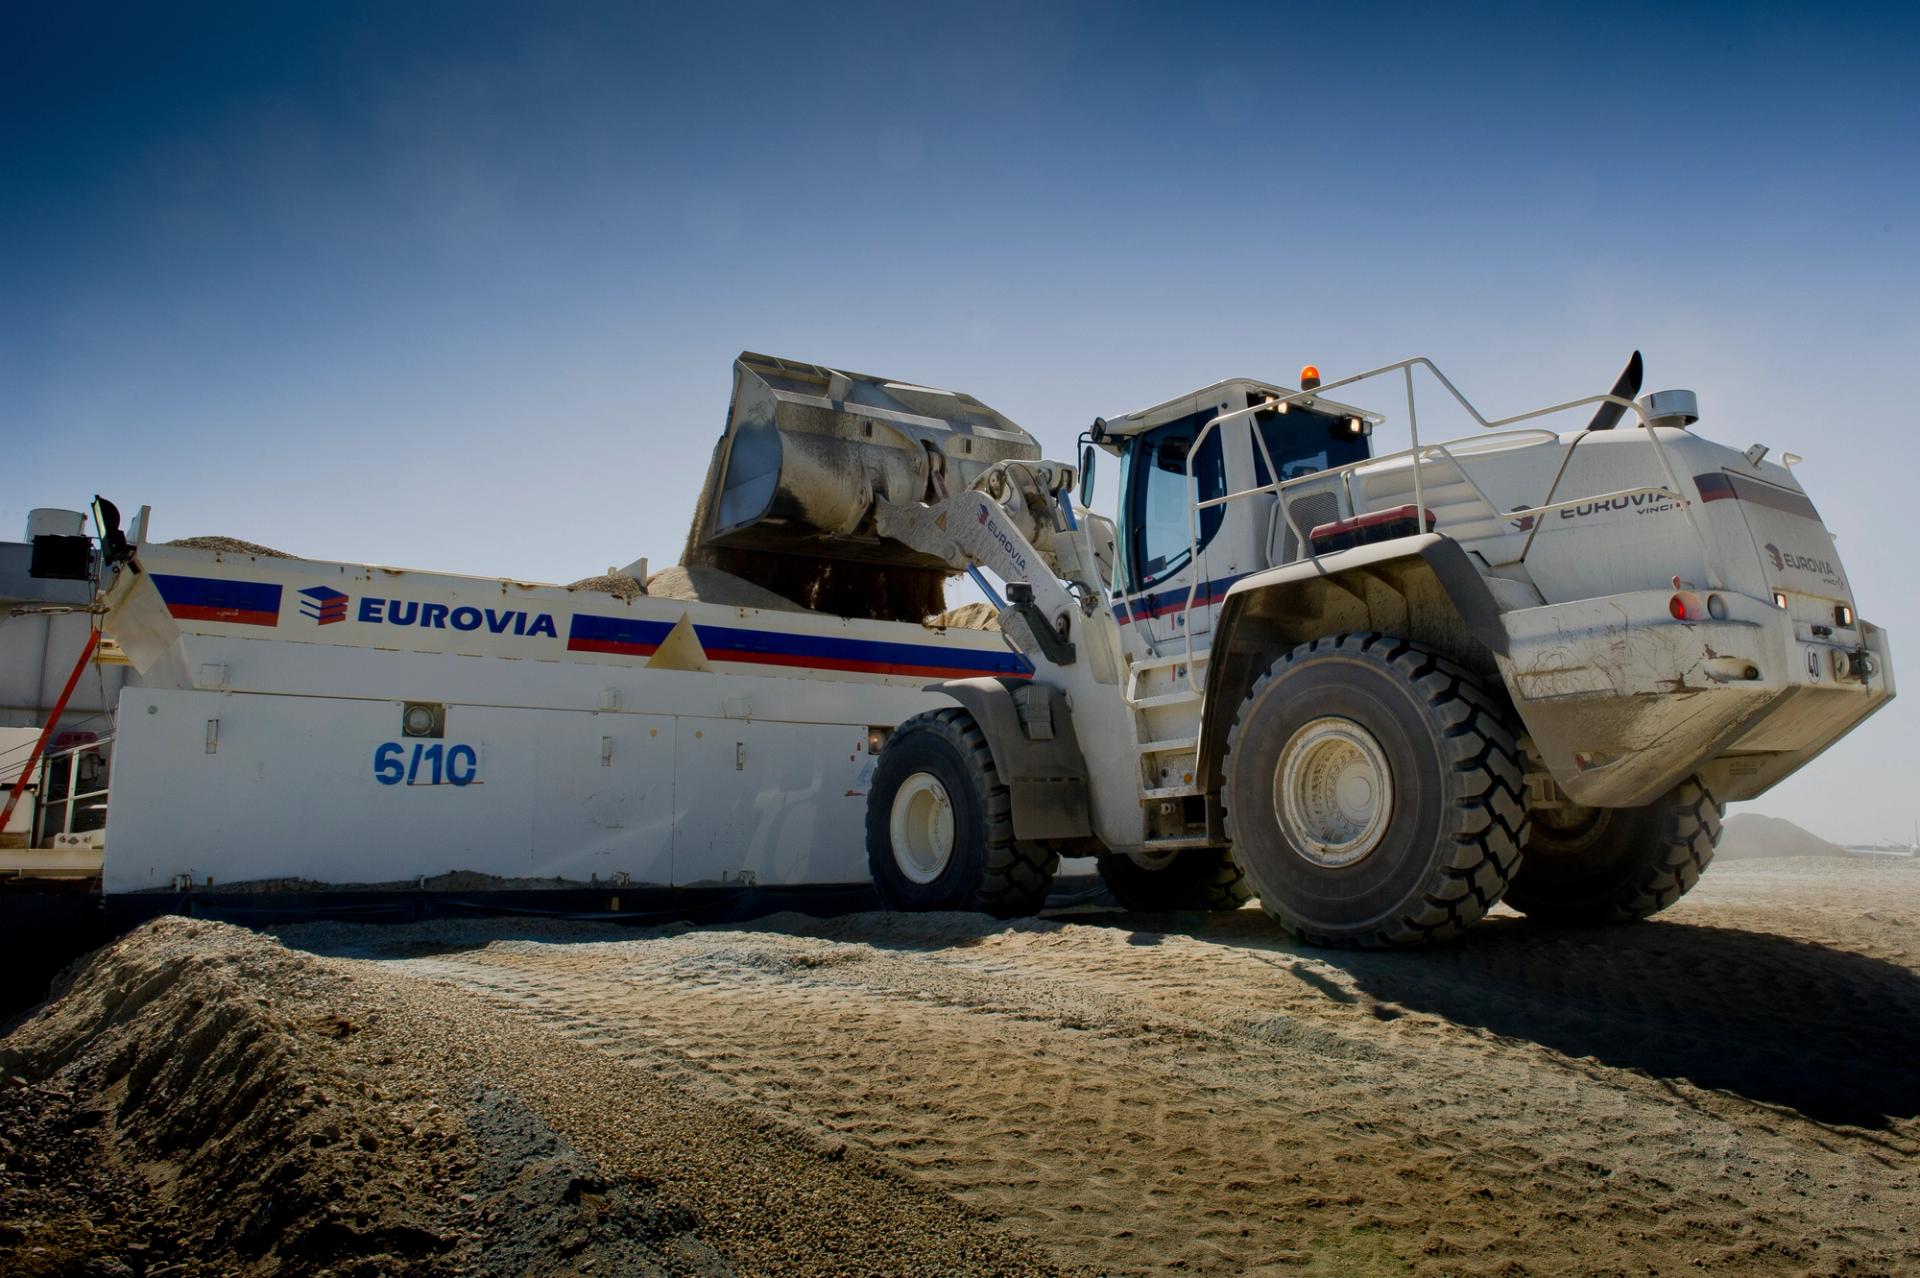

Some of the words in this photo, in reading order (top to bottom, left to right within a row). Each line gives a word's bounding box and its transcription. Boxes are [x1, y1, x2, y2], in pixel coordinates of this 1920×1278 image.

[1637, 504, 1673, 515] VINCI
[987, 520, 1026, 572] EUROVIA
[1783, 553, 1834, 576] EUROVIA
[358, 597, 558, 638] EUROVIA
[1807, 651, 1819, 677] 40
[374, 742, 477, 787] 6/10
